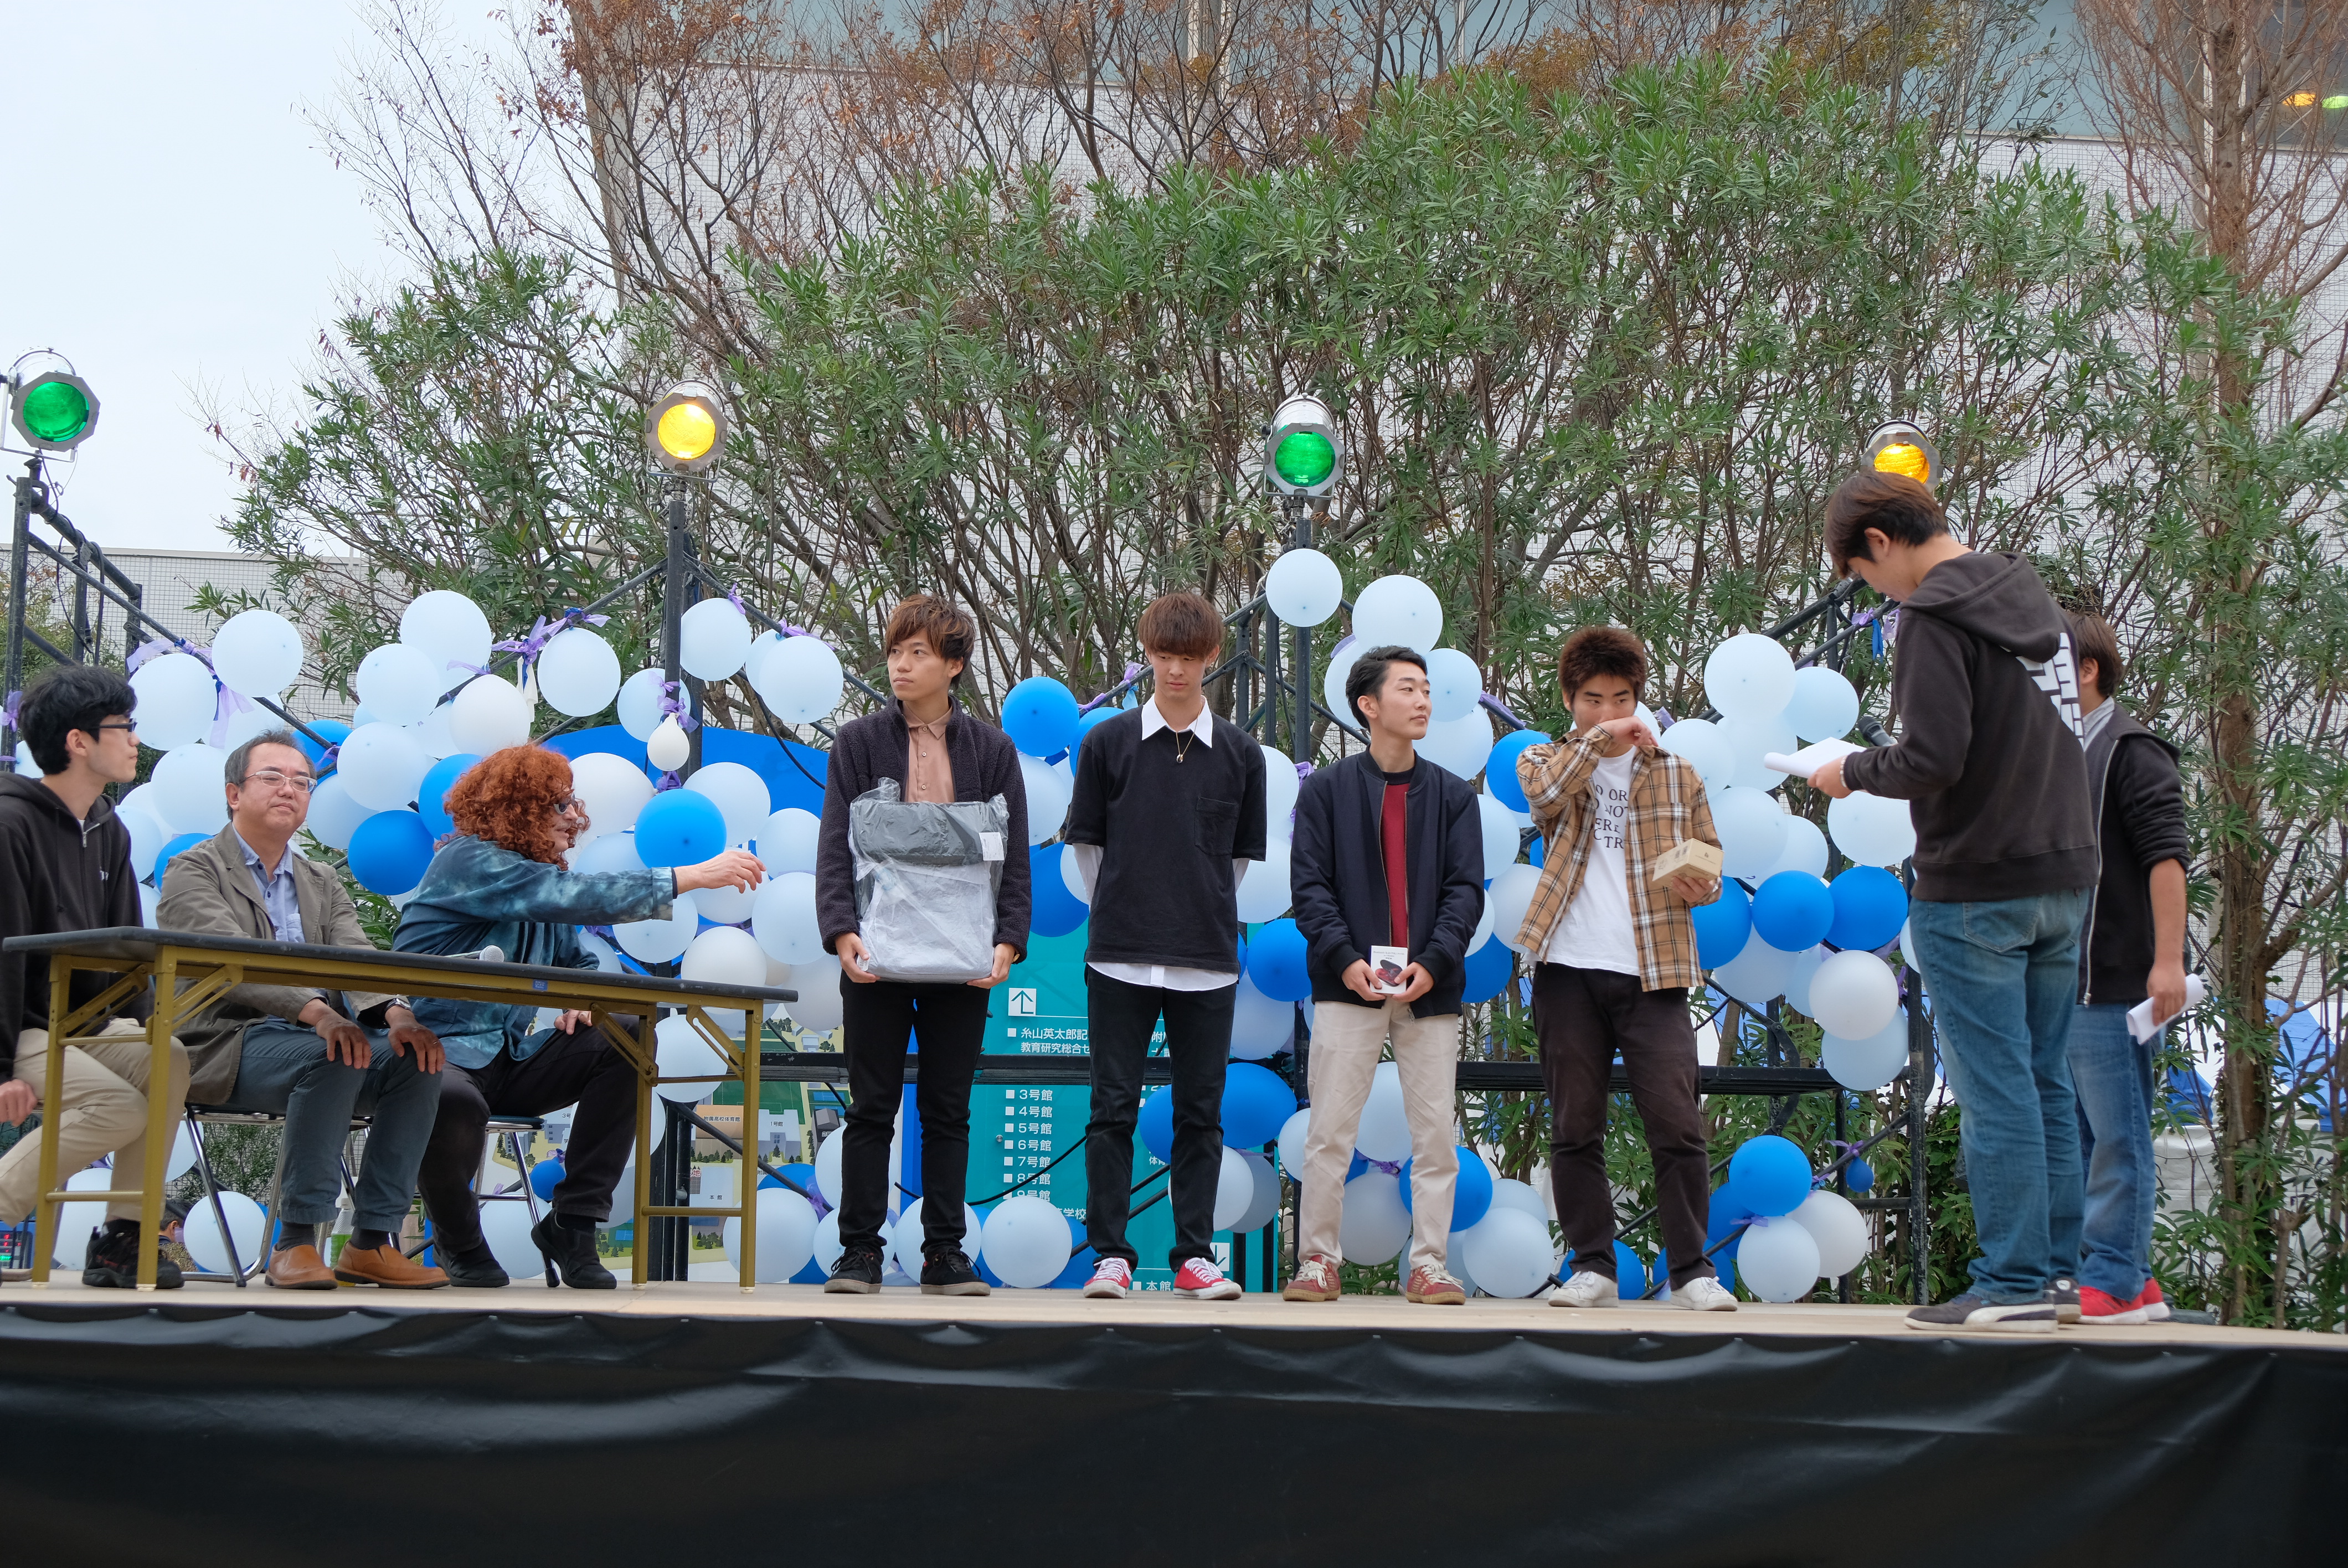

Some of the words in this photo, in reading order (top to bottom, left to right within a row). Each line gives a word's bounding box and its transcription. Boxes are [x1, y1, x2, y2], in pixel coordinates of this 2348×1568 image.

[1609, 789, 1628, 801] OR
[1021, 1028, 1088, 1040] 糸山英太郎記
[1151, 1031, 1167, 1043] 附
[1019, 1089, 1053, 1101] 3号館
[1018, 1106, 1052, 1118] 4号館
[1018, 1123, 1052, 1134] 5号館
[1018, 1140, 1052, 1151] 6号館
[1017, 1156, 1051, 1168] 7号館
[1017, 1173, 1051, 1185] 8号館
[1058, 1208, 1087, 1220] 学校
[1146, 1281, 1171, 1291] 本館
